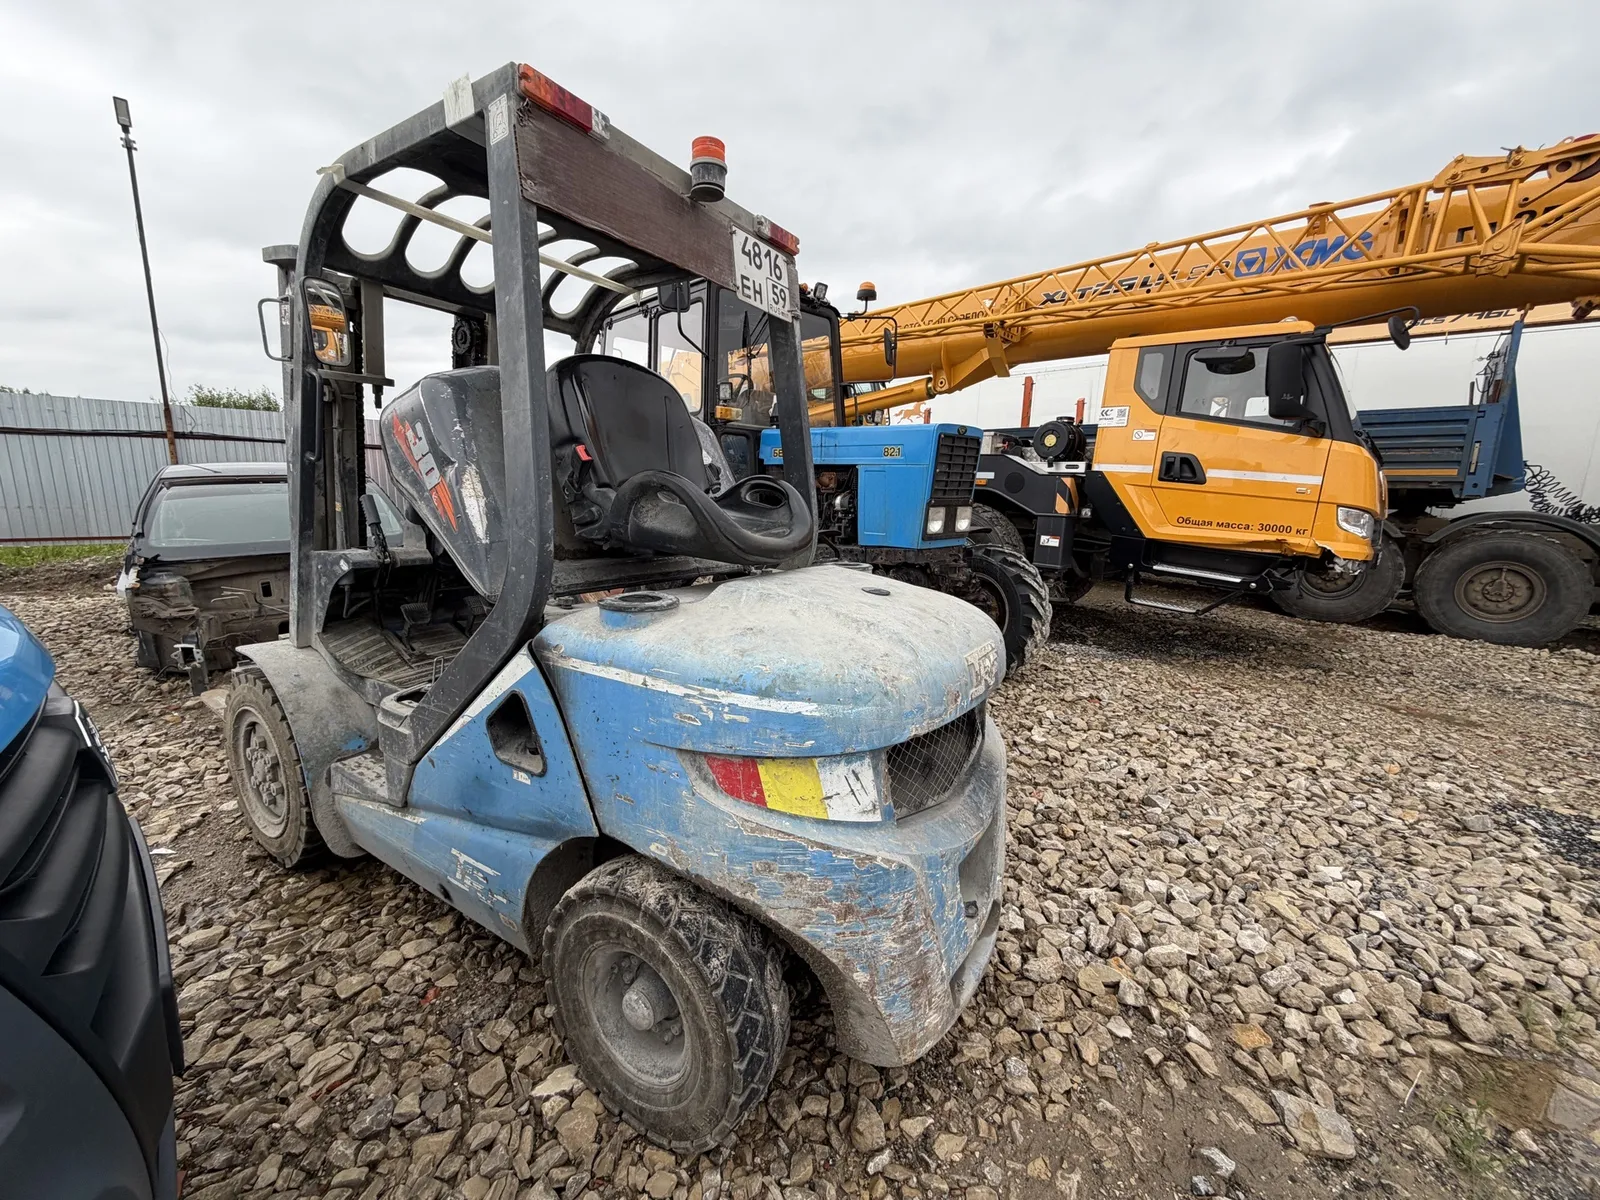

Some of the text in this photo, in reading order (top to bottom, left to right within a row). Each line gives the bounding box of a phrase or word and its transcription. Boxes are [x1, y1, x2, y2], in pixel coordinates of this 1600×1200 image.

[741, 236, 782, 281] 4816
[1264, 231, 1374, 273] XCMG
[772, 284, 786, 308] 59
[1176, 516, 1309, 536] Общая масса: 30000 кг
